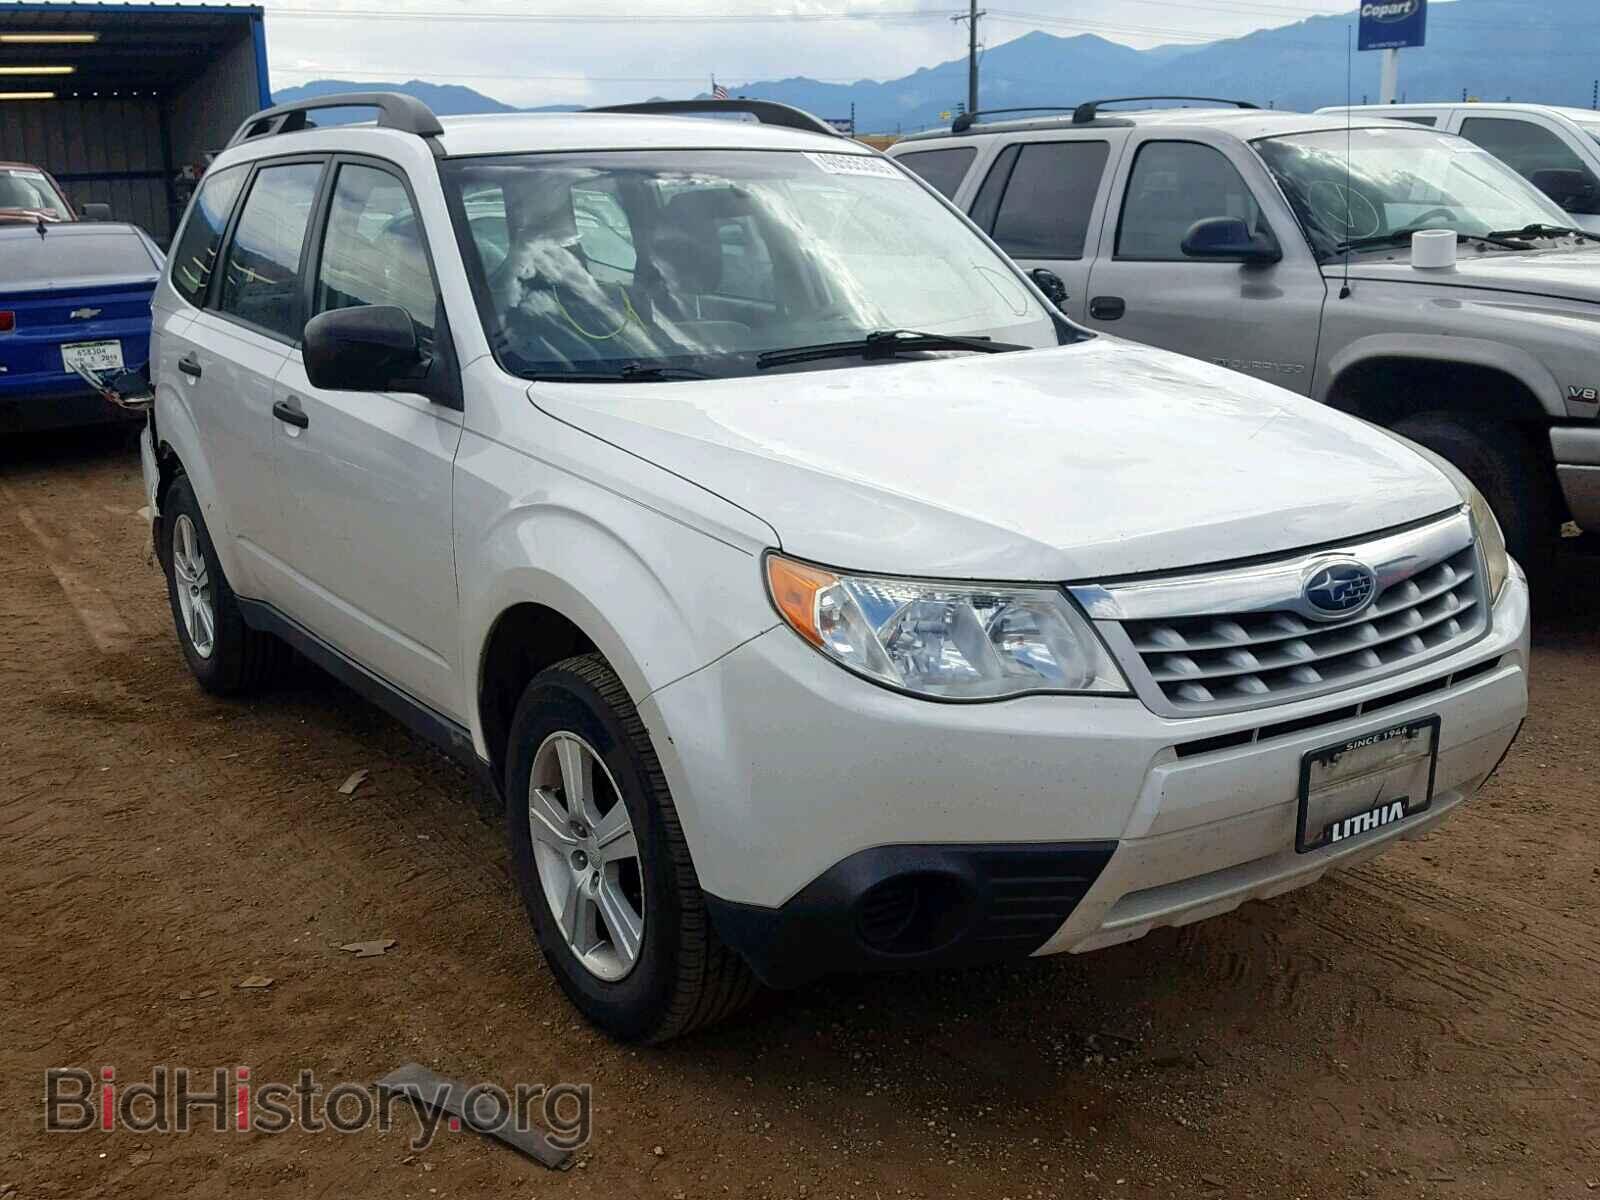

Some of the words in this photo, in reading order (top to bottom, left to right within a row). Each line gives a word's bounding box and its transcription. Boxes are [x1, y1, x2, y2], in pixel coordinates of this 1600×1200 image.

[1361, 1, 1411, 18] Copart
[1568, 386, 1596, 399] V8
[1346, 735, 1382, 751] SINCE
[1332, 801, 1404, 842] LITHIA
